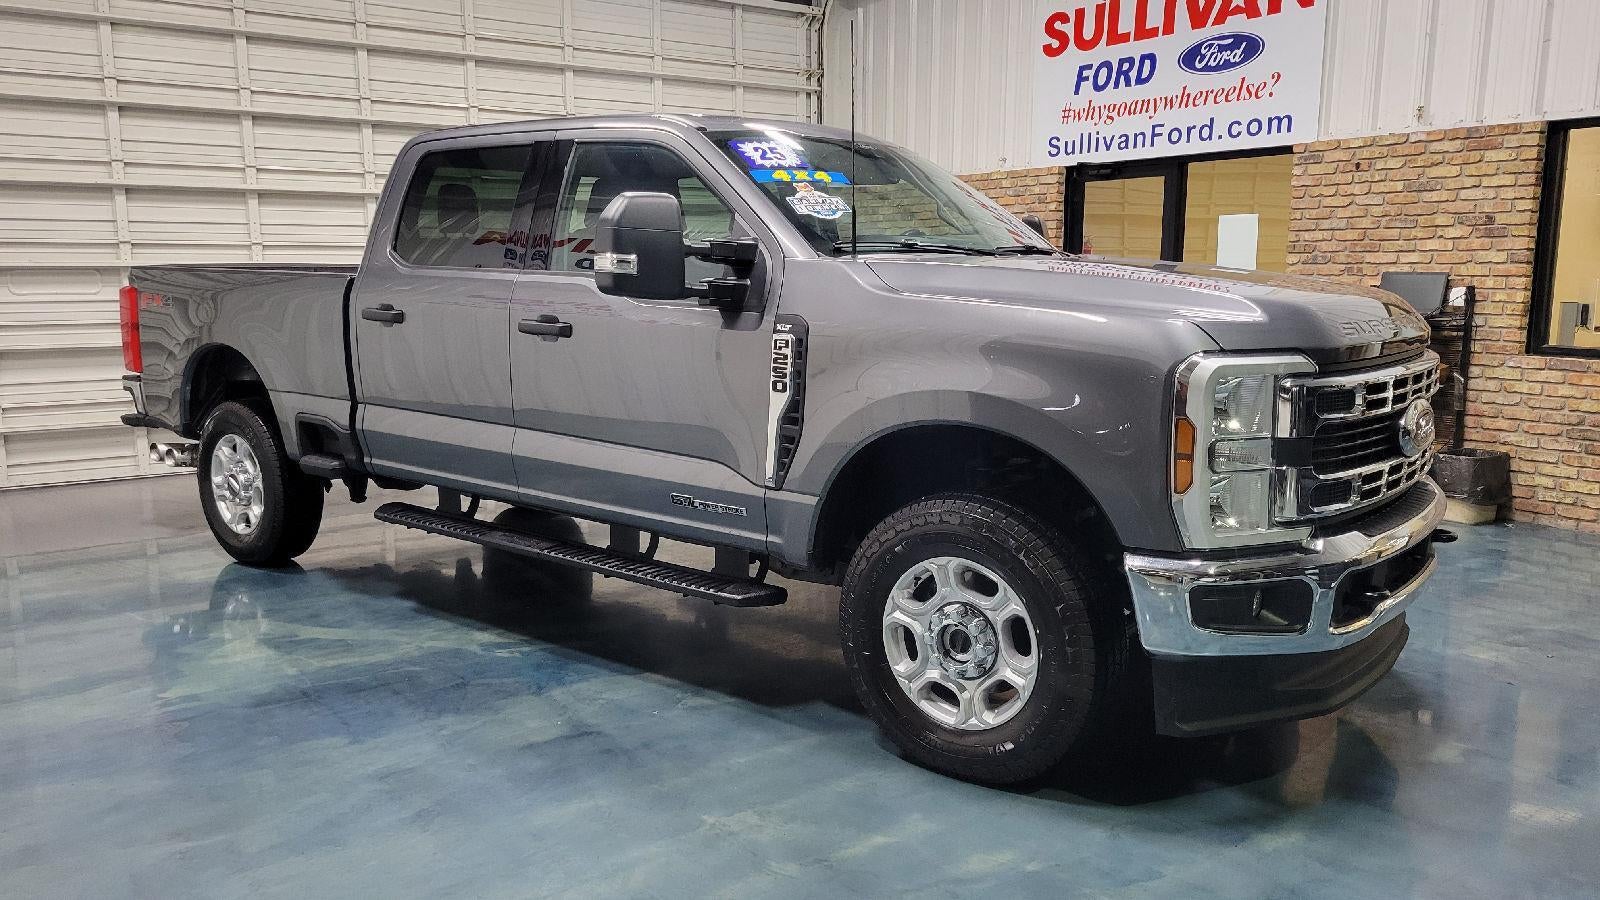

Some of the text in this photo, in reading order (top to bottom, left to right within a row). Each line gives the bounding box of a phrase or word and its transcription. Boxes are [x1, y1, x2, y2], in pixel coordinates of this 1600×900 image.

[1194, 38, 1245, 69] Ford
[1073, 52, 1158, 96] FORD
[1060, 71, 1282, 126] #whygoanywhereelse?
[752, 146, 787, 161] 25
[1047, 113, 1293, 158] SullivanFord.com
[776, 323, 792, 331] XLT
